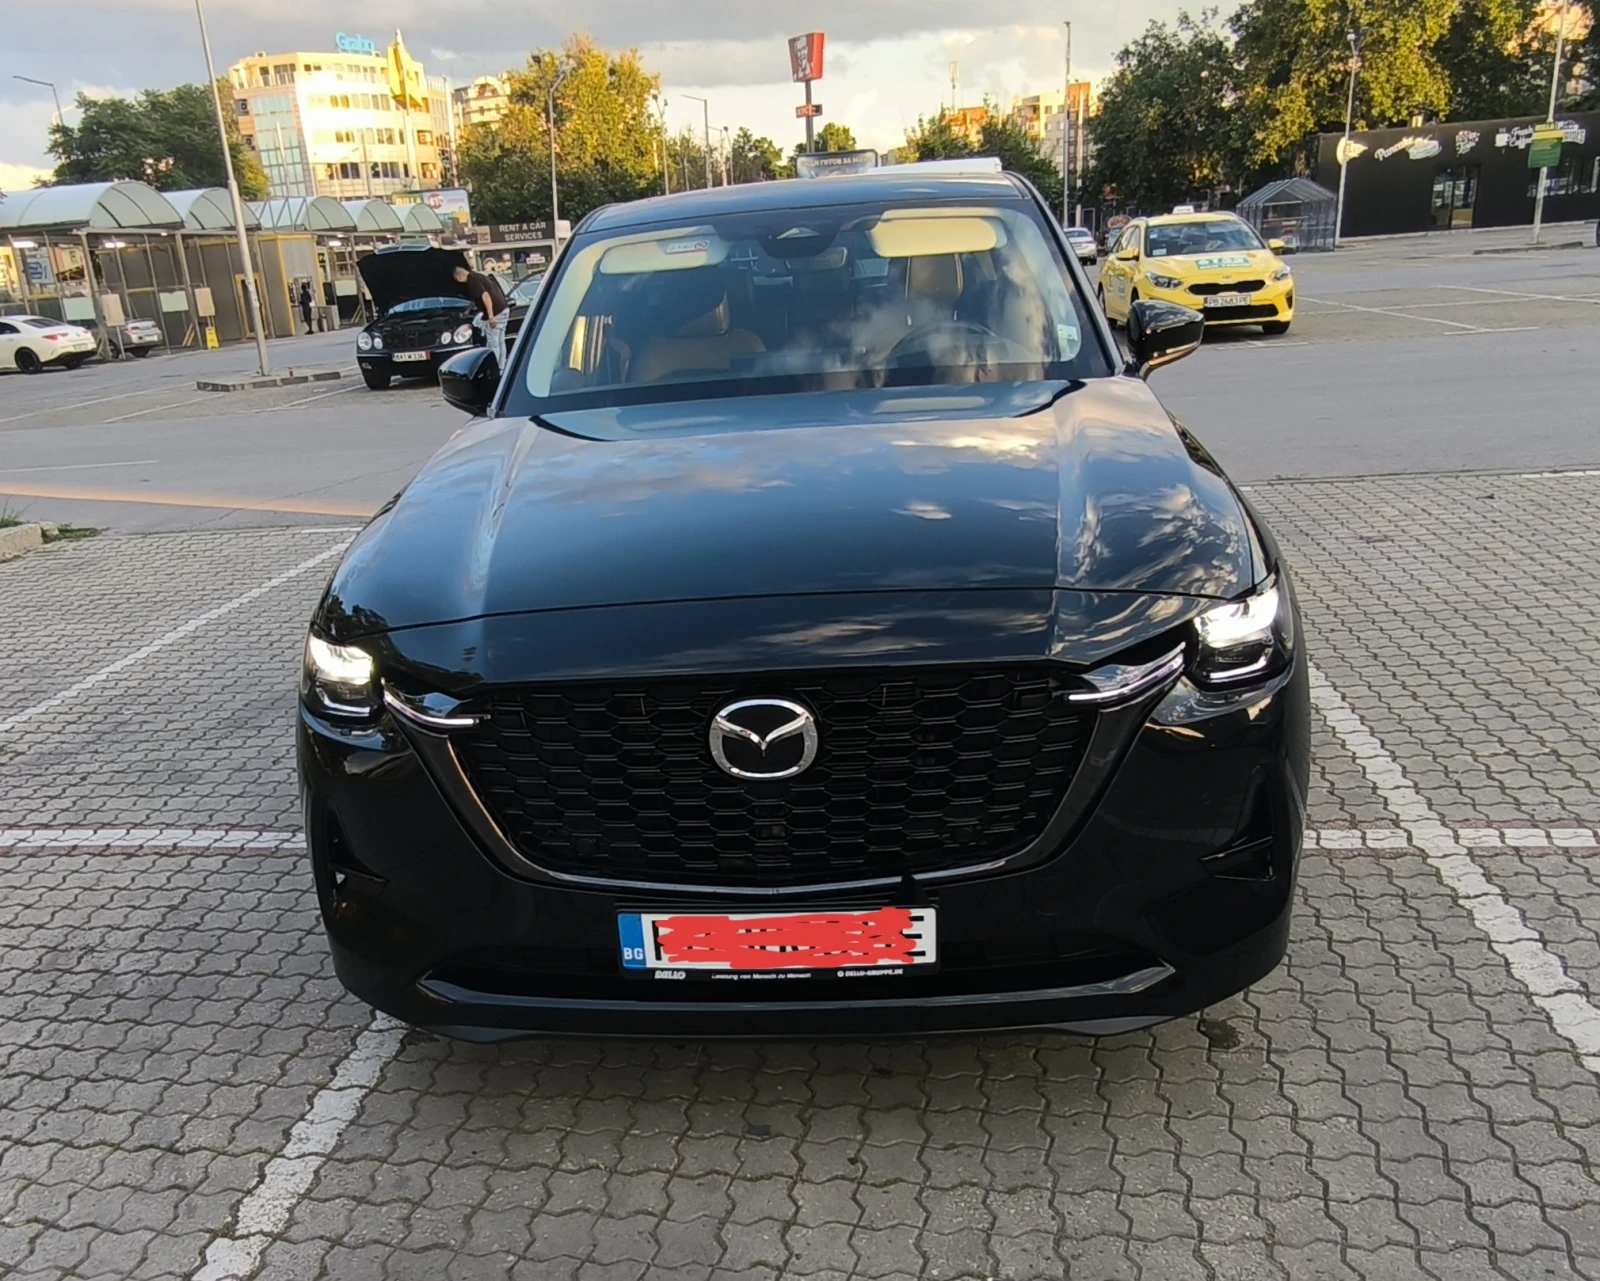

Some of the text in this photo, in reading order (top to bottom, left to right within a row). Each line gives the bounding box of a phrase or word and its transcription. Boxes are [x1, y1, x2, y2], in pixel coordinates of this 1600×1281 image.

[498, 222, 546, 233] RENT A CAR
[504, 232, 543, 241] SERVICES
[623, 947, 644, 960] BG
[654, 970, 686, 980] DELLO
